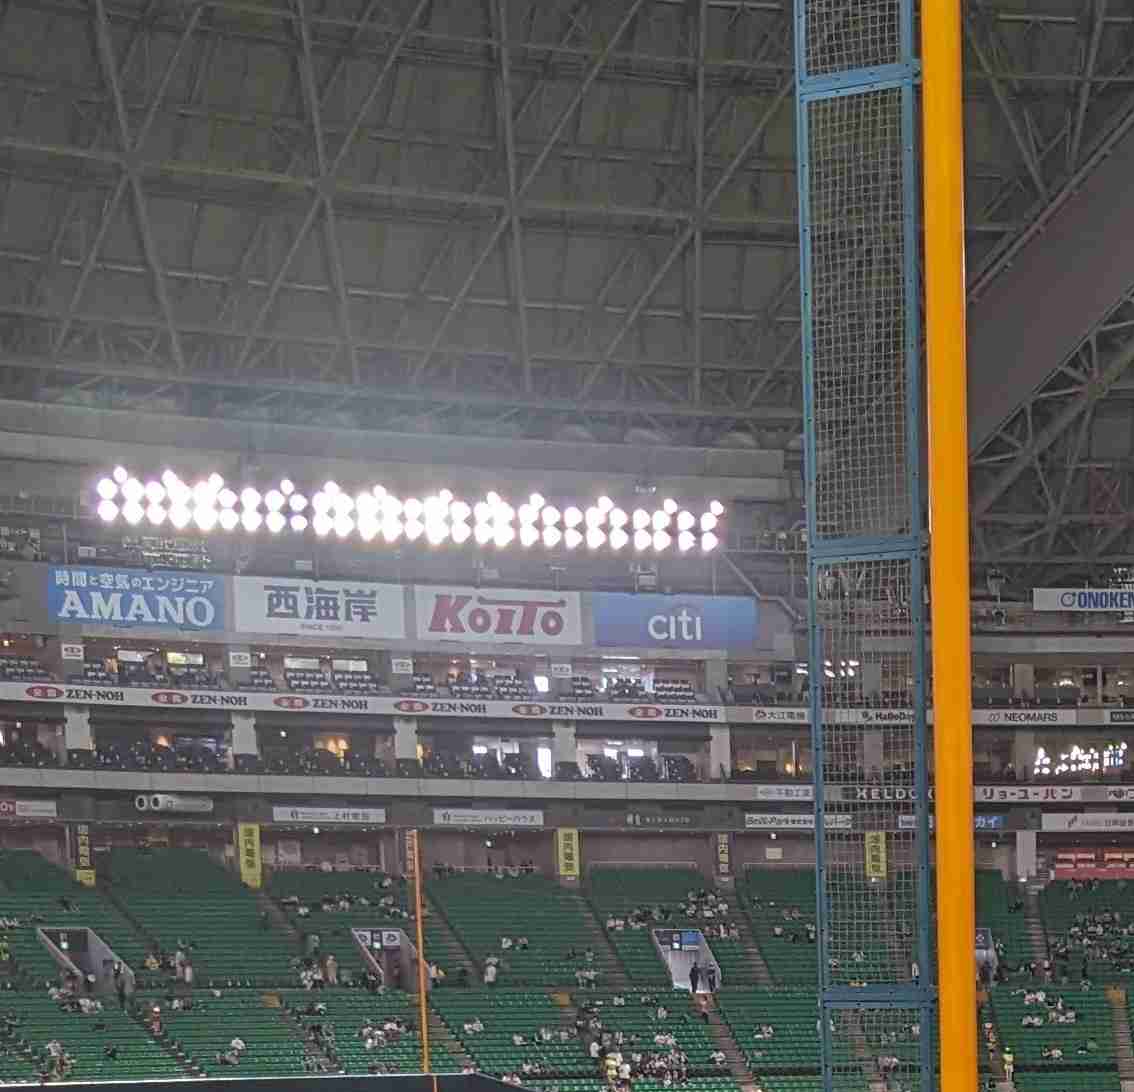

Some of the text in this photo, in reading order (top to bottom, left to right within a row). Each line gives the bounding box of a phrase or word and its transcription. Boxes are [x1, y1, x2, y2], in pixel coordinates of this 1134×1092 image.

[55, 570, 213, 592] 時間と空気のエンジニア
[58, 591, 215, 627] AMANO
[264, 585, 378, 622] 西海岸
[648, 609, 703, 640] citi
[65, 689, 125, 701] ZEN-NOH
[190, 694, 248, 706] ZEN-NOH
[312, 699, 369, 710] ZEN-NOH
[431, 703, 487, 714] ZEN-NOH
[549, 706, 604, 717] ZEN-NOH
[665, 708, 718, 719] ZEN-NOH
[1003, 711, 1058, 722] NEOMARS
